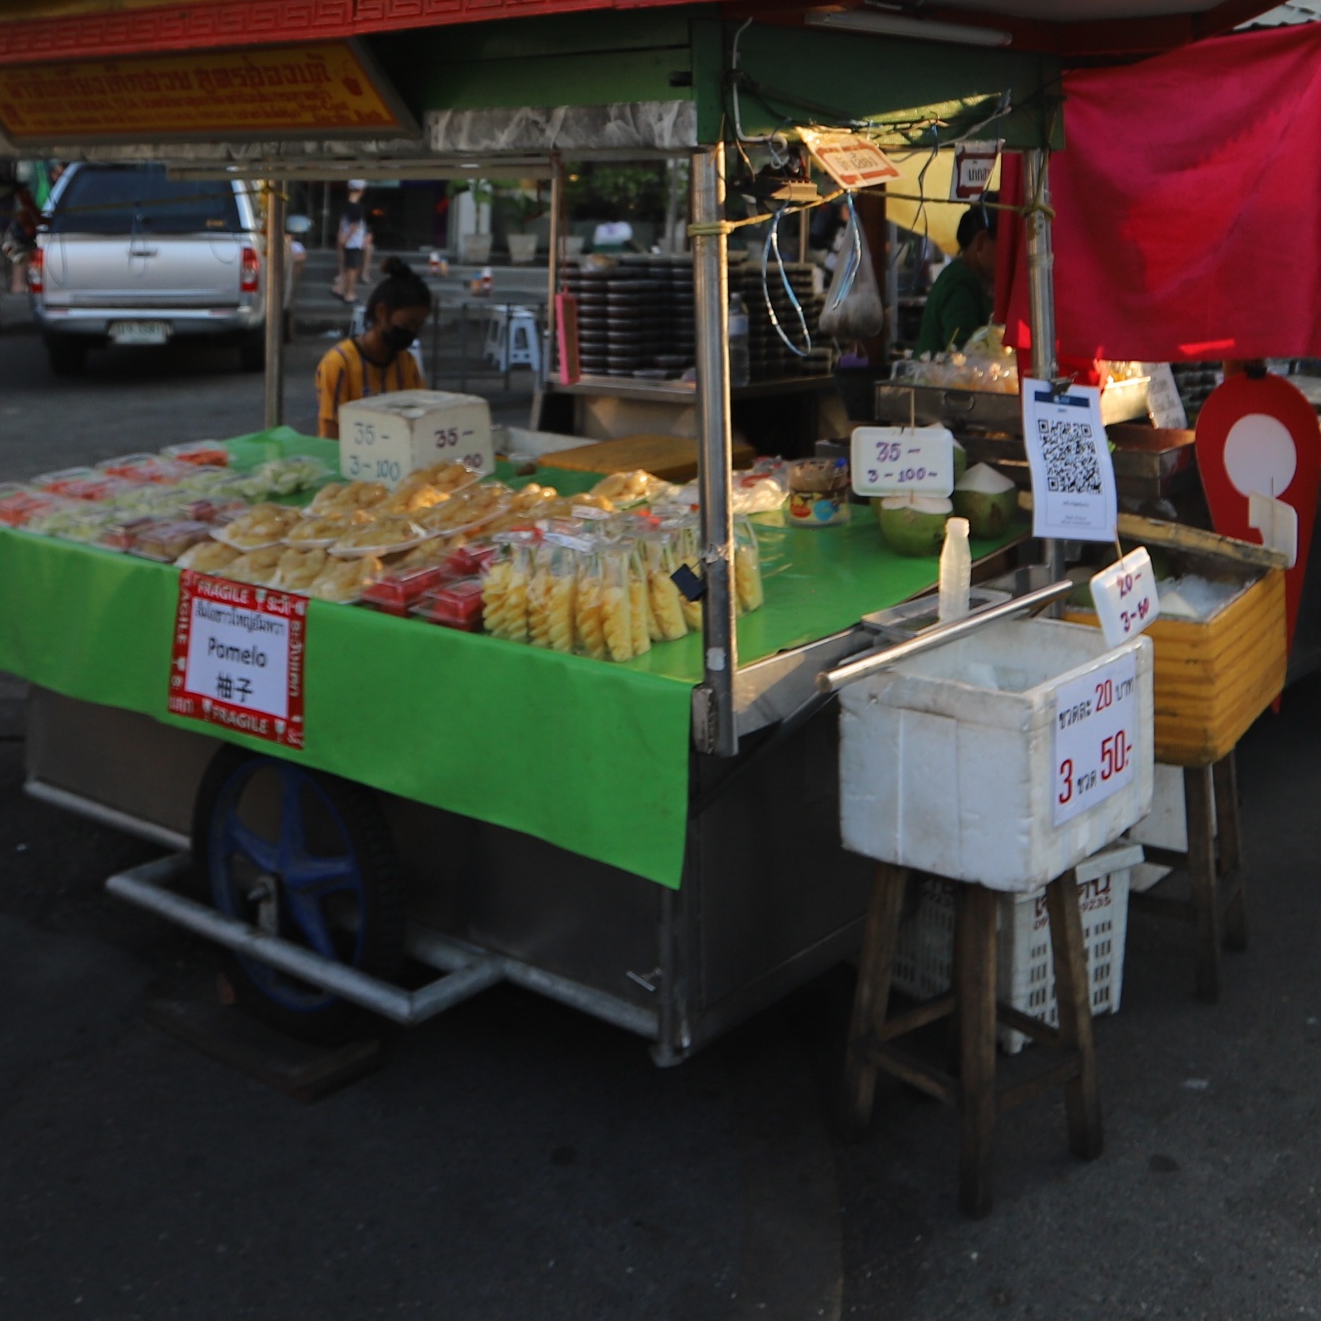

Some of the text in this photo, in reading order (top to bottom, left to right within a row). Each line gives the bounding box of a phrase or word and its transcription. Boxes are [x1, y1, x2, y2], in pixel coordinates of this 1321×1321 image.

[197, 581, 250, 605] FRAGILE
[207, 636, 268, 669] Pomelo
[1095, 679, 1113, 713] 20
[212, 706, 270, 735] FRAGILE
[1058, 758, 1074, 805] 3
